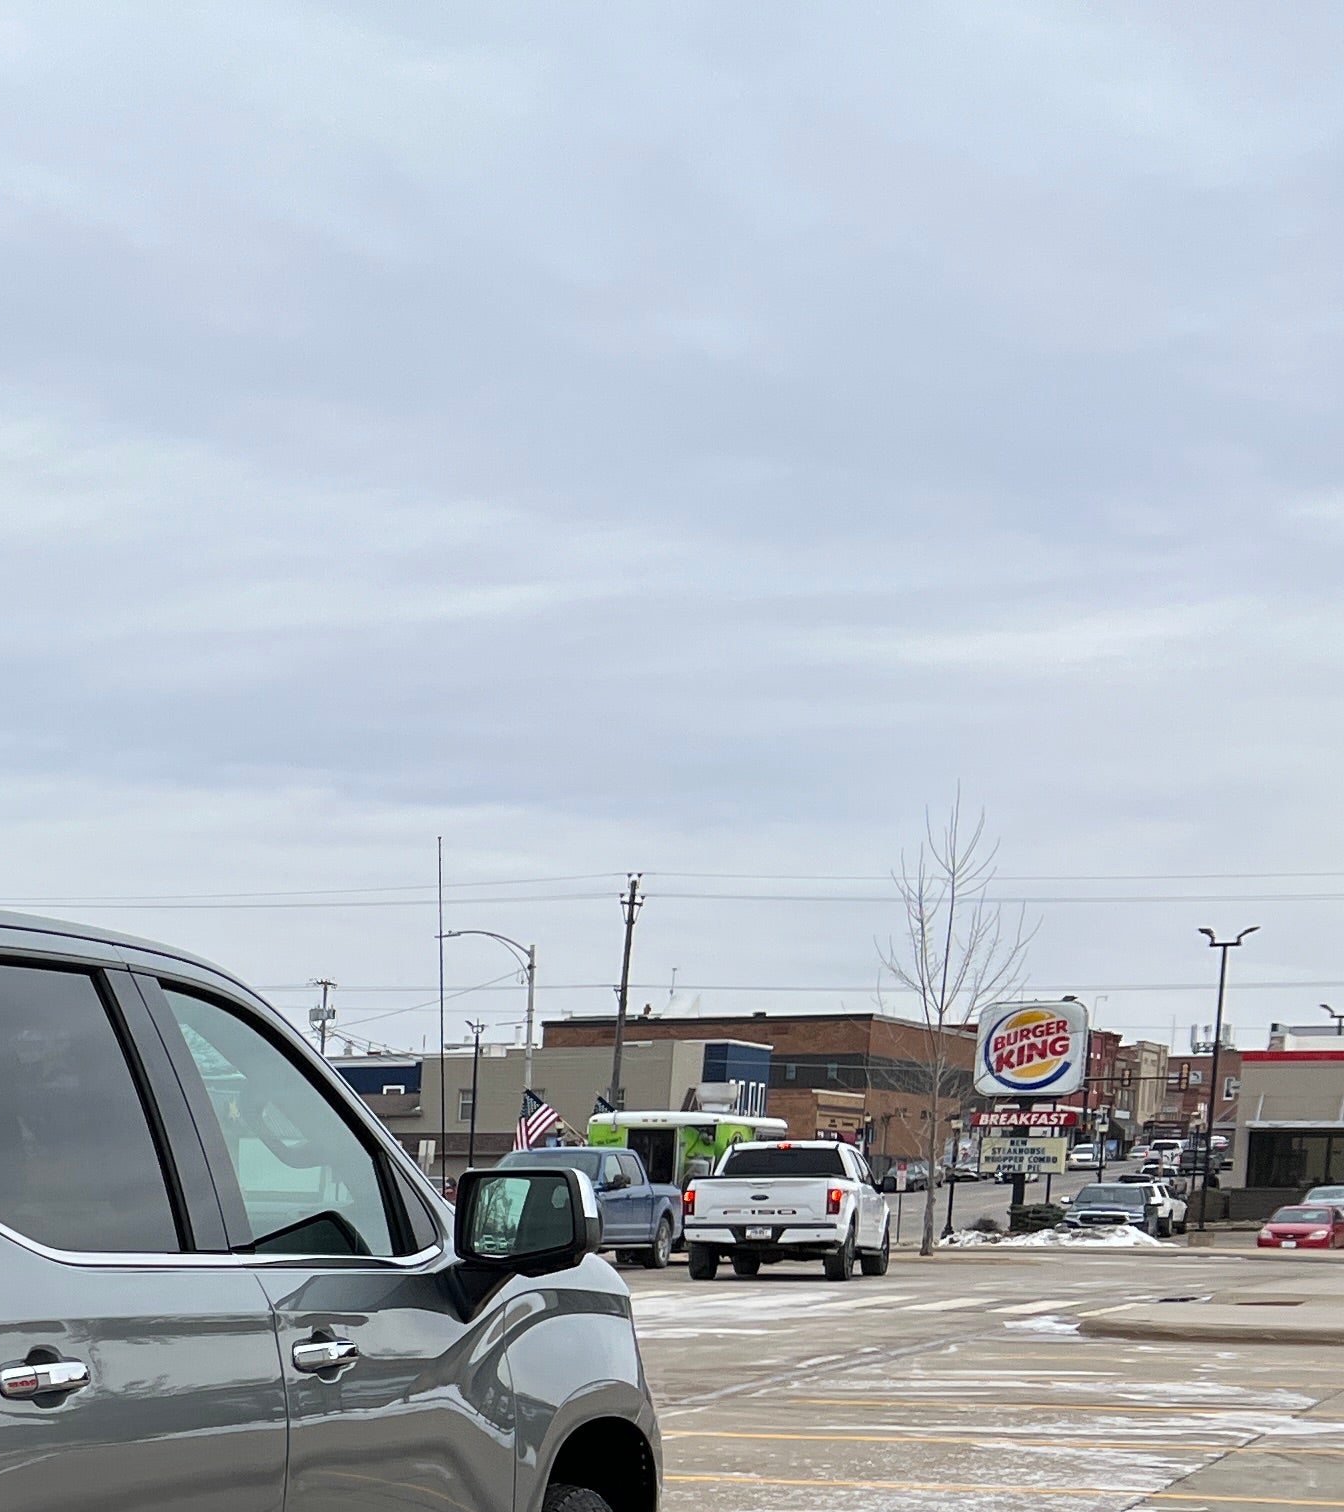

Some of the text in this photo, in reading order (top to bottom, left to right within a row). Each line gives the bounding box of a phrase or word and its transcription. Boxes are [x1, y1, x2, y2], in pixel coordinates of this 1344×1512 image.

[993, 1019, 1068, 1053] BURGER
[995, 1035, 1070, 1073] KING
[979, 1113, 1068, 1126] BREAKFAST
[1027, 1155, 1058, 1164] COMBO
